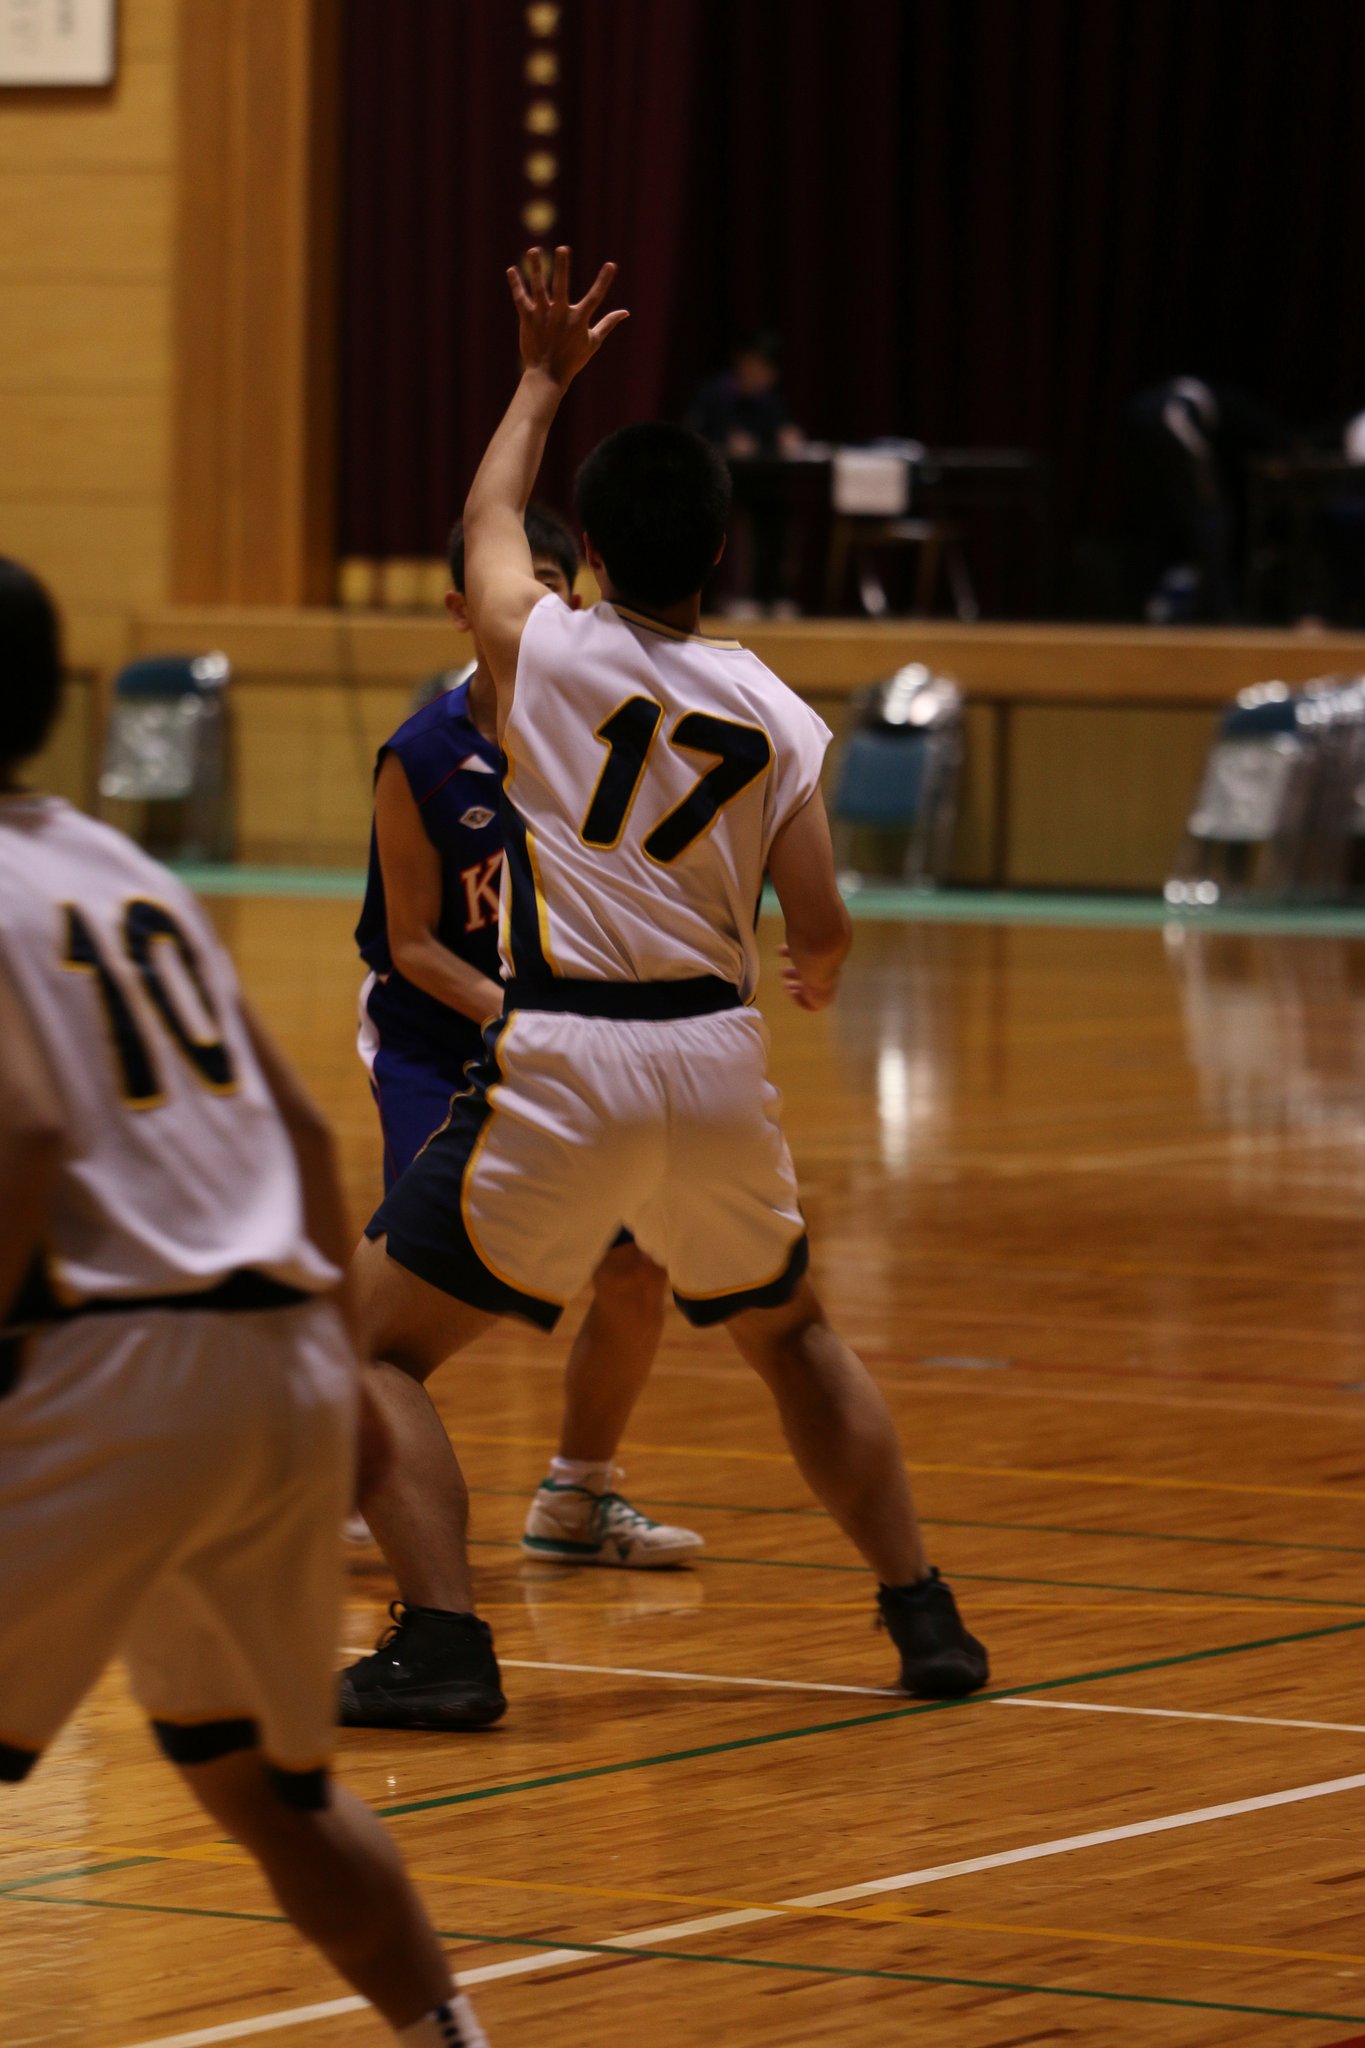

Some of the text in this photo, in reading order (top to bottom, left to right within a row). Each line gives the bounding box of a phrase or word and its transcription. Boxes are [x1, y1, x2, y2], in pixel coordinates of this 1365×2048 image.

[579, 694, 771, 865] 17
[461, 848, 504, 933] K
[58, 897, 238, 1110] 10
